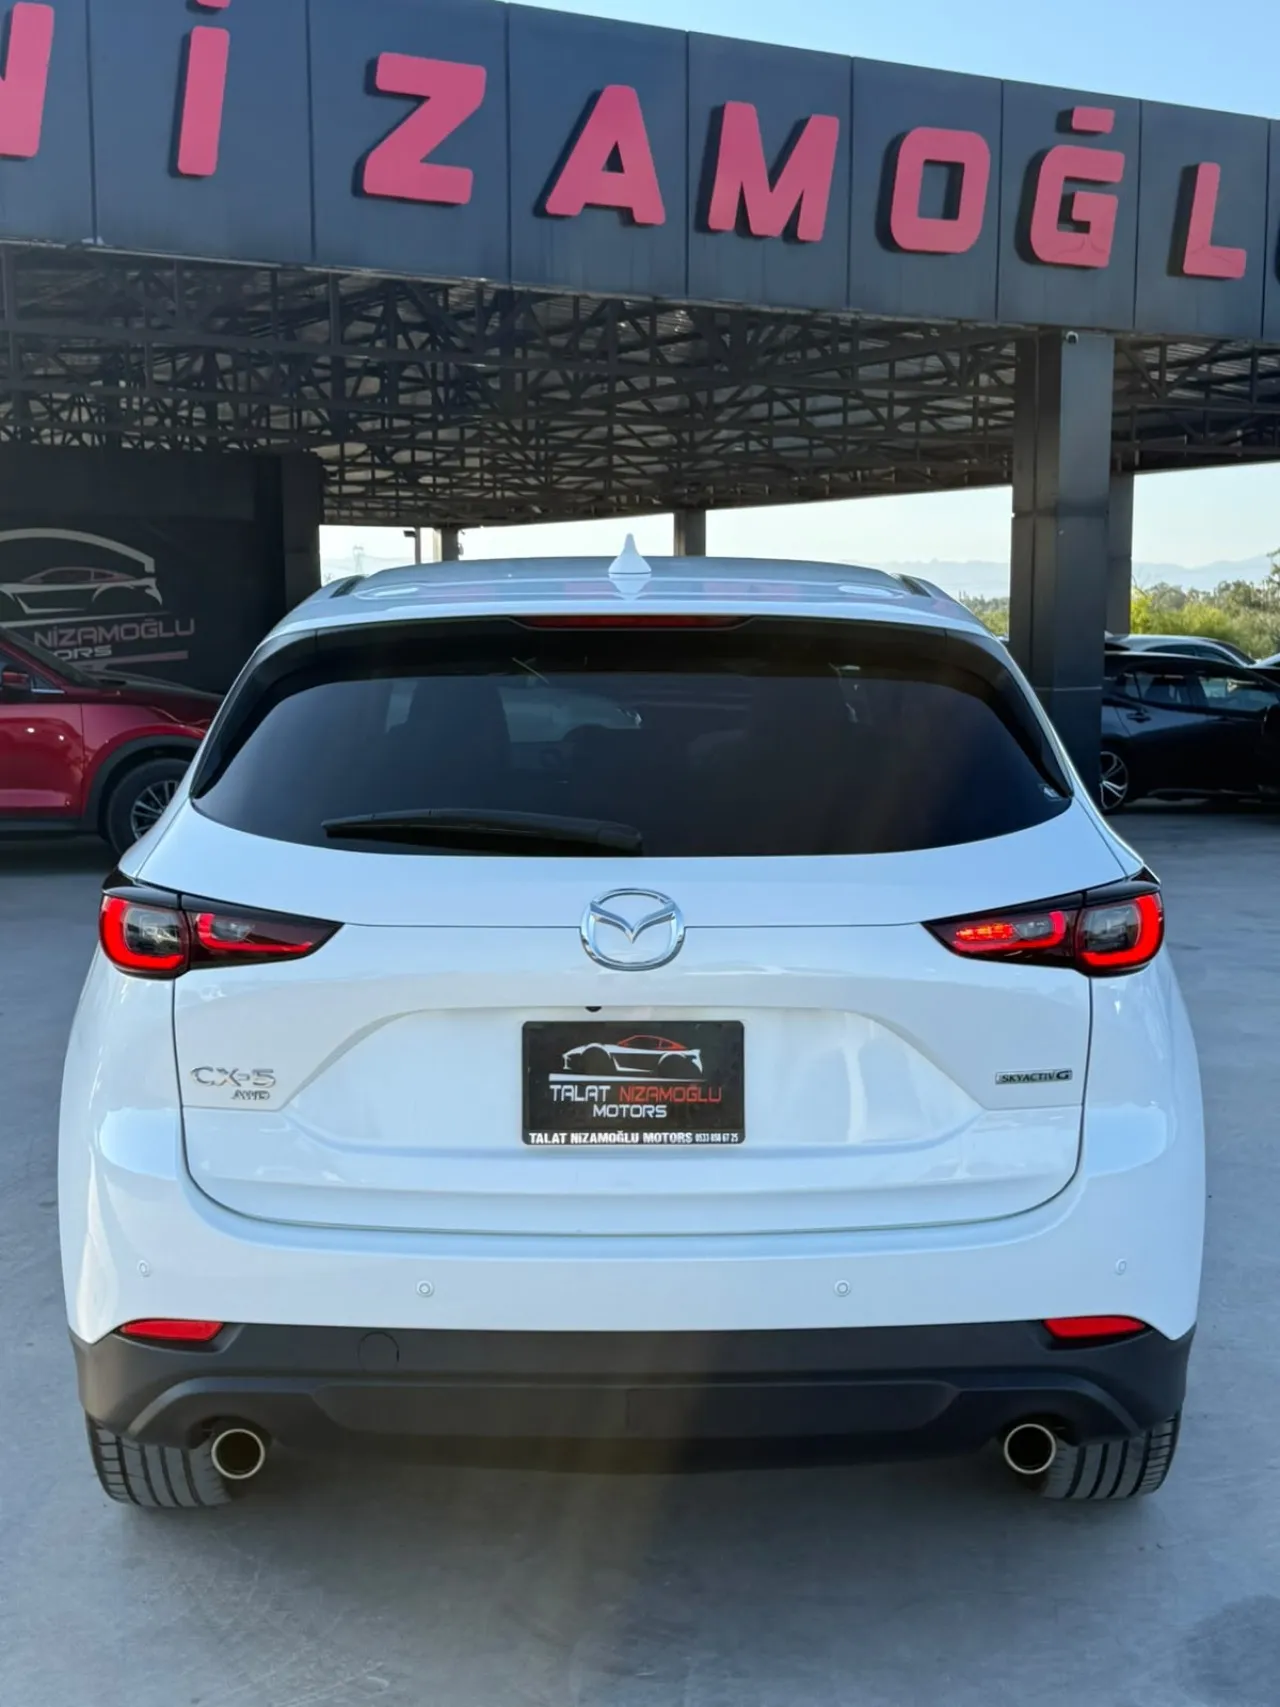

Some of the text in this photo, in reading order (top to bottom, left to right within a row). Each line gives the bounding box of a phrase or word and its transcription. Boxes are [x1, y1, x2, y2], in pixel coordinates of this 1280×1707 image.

[0, 0, 1250, 279] İZAMOĞL
[53, 644, 112, 661] ORS
[190, 1066, 276, 1088] CX-5
[231, 1089, 270, 1101] AWD
[550, 1085, 611, 1102] TALAT
[593, 1104, 667, 1118] MOTORS
[529, 1132, 567, 1144] TALAT
[643, 1132, 693, 1144] MOTORS
